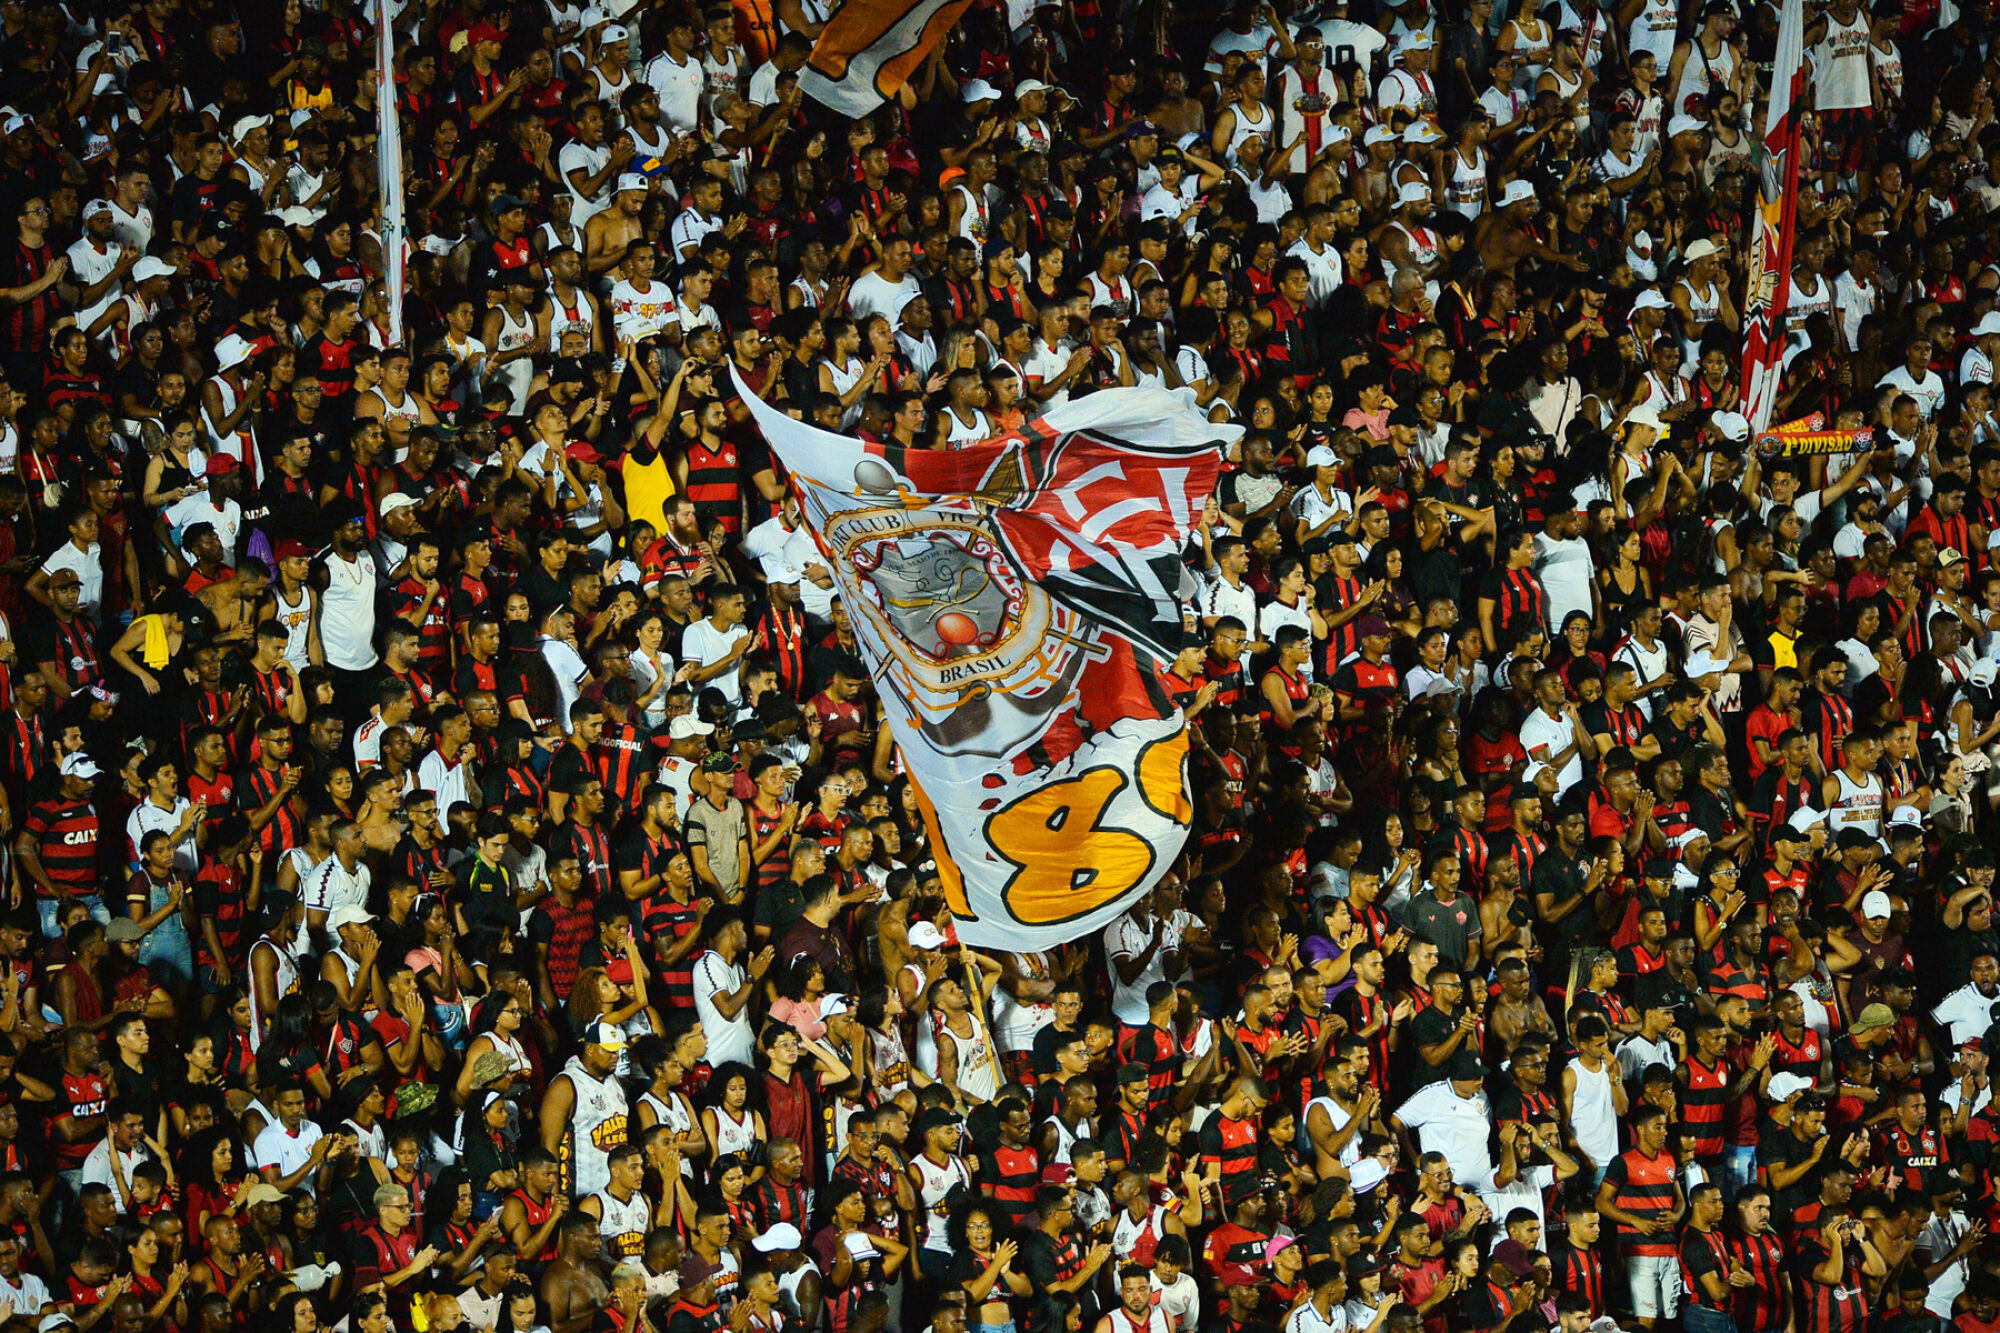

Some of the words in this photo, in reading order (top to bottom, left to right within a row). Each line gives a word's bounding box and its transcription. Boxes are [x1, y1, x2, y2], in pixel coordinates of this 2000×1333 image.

[1798, 430, 1853, 455] DIVISÃO
[848, 514, 901, 534] CLUB
[940, 656, 1012, 683] BRASIL
[1907, 1157, 1937, 1168] CAIXA
